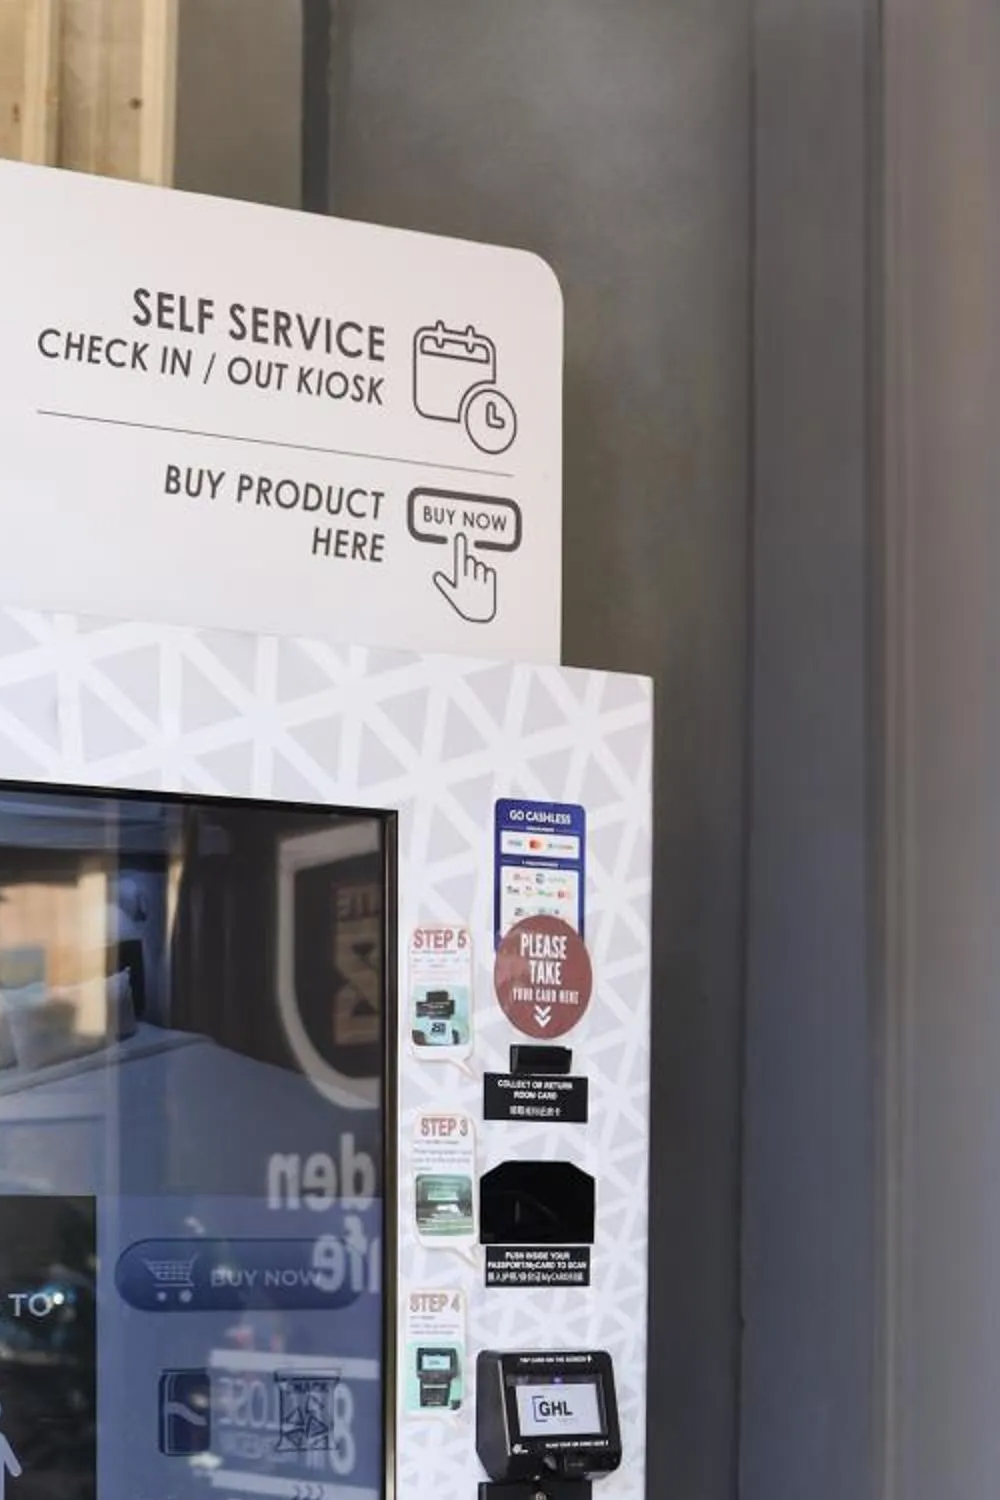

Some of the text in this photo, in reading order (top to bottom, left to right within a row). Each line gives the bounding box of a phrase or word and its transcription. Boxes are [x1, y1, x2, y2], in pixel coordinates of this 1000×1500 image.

[133, 288, 385, 361] SELF SERVICE
[37, 329, 384, 405] CHECK IN / OUT KIOSK
[164, 465, 385, 520] BUY PRODUCT
[423, 505, 508, 532] BUY NOW
[312, 526, 385, 562] HERE
[509, 810, 572, 825] GO CASHLESS
[414, 929, 453, 949] STEP
[520, 933, 568, 960] PLEASE
[529, 962, 562, 986] TAKE
[512, 987, 579, 1004] YOUR CARD HERE
[498, 1080, 530, 1088] COLLECT
[544, 1082, 573, 1090] RETURN
[420, 1118, 468, 1136] STEP 3
[210, 1269, 322, 1287] BUY NOW
[9, 1293, 52, 1317] TO
[410, 1295, 460, 1313] STEP 4
[538, 1401, 573, 1417] GHL
